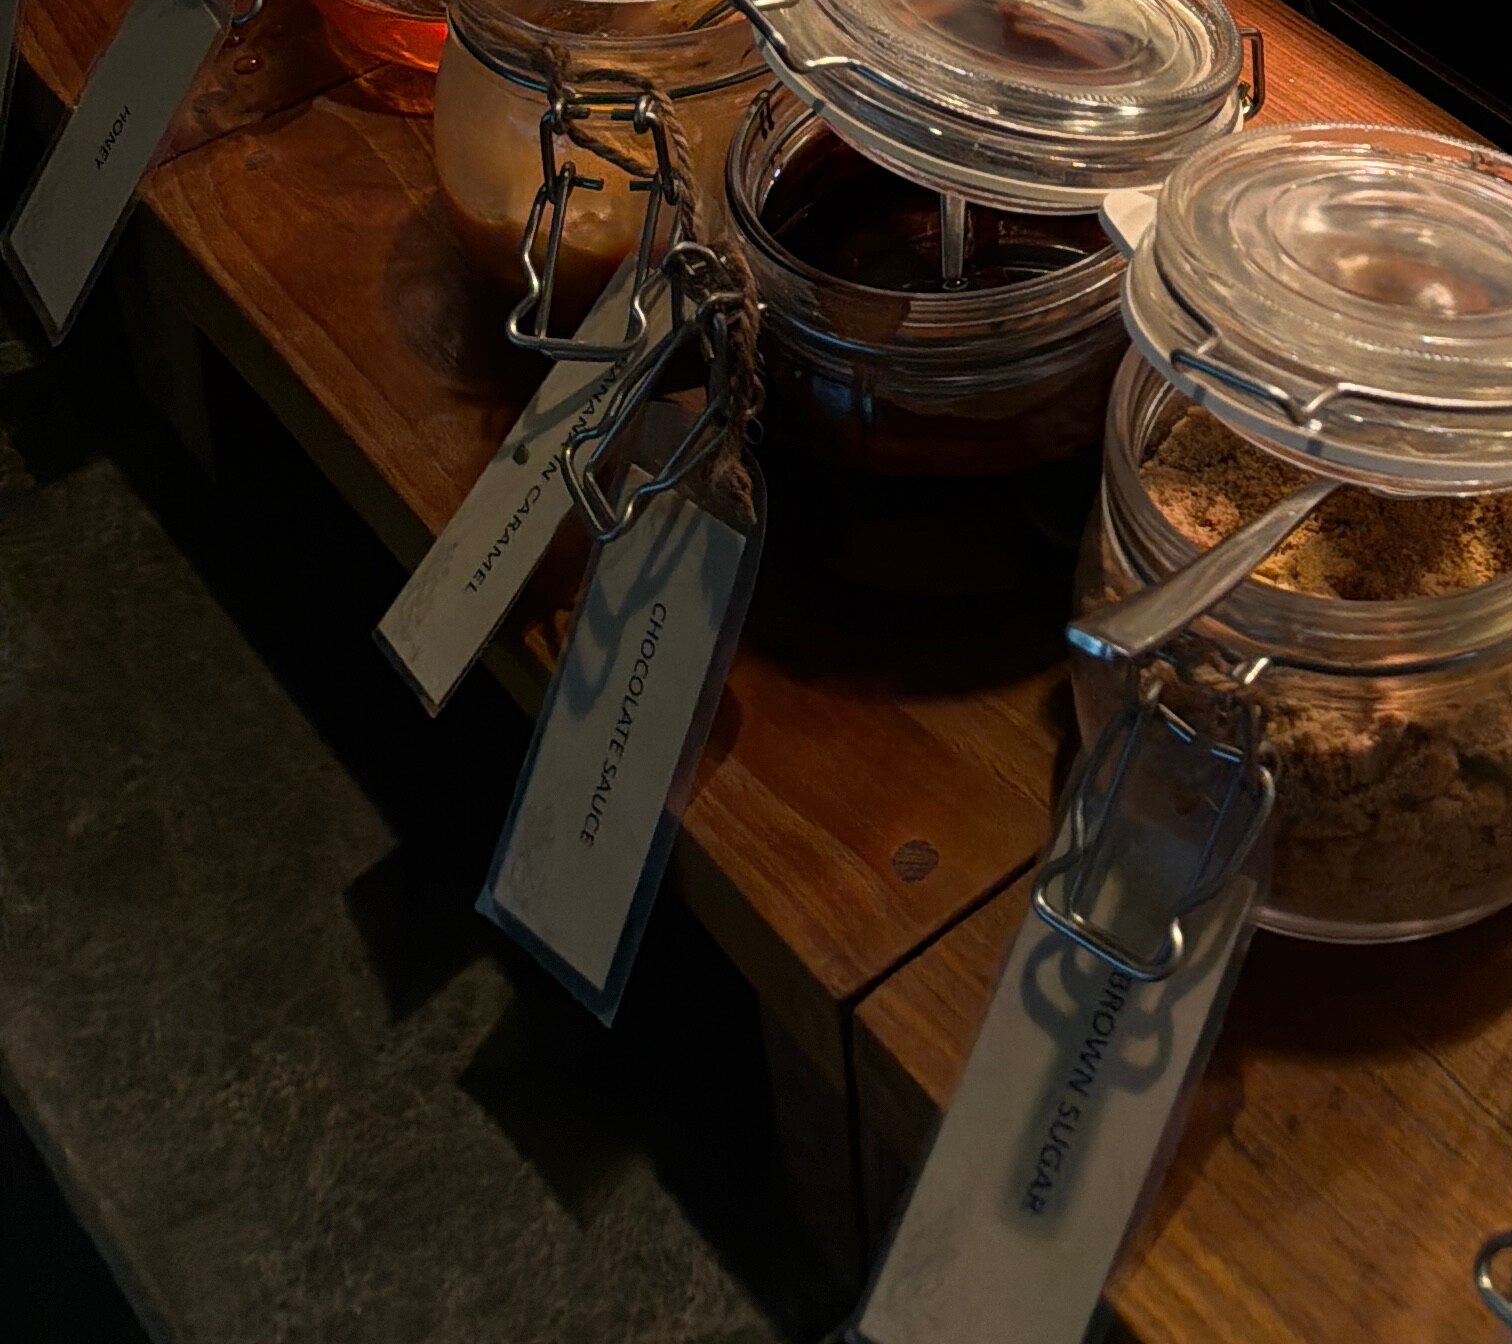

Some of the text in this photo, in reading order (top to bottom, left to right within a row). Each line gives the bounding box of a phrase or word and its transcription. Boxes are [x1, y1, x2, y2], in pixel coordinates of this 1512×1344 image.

[94, 105, 132, 170] HONEY
[466, 485, 541, 592] CARAMEL
[580, 602, 666, 847] CHOCOLATE SAUCE
[1022, 970, 1132, 1214] BROWN SUGAR
